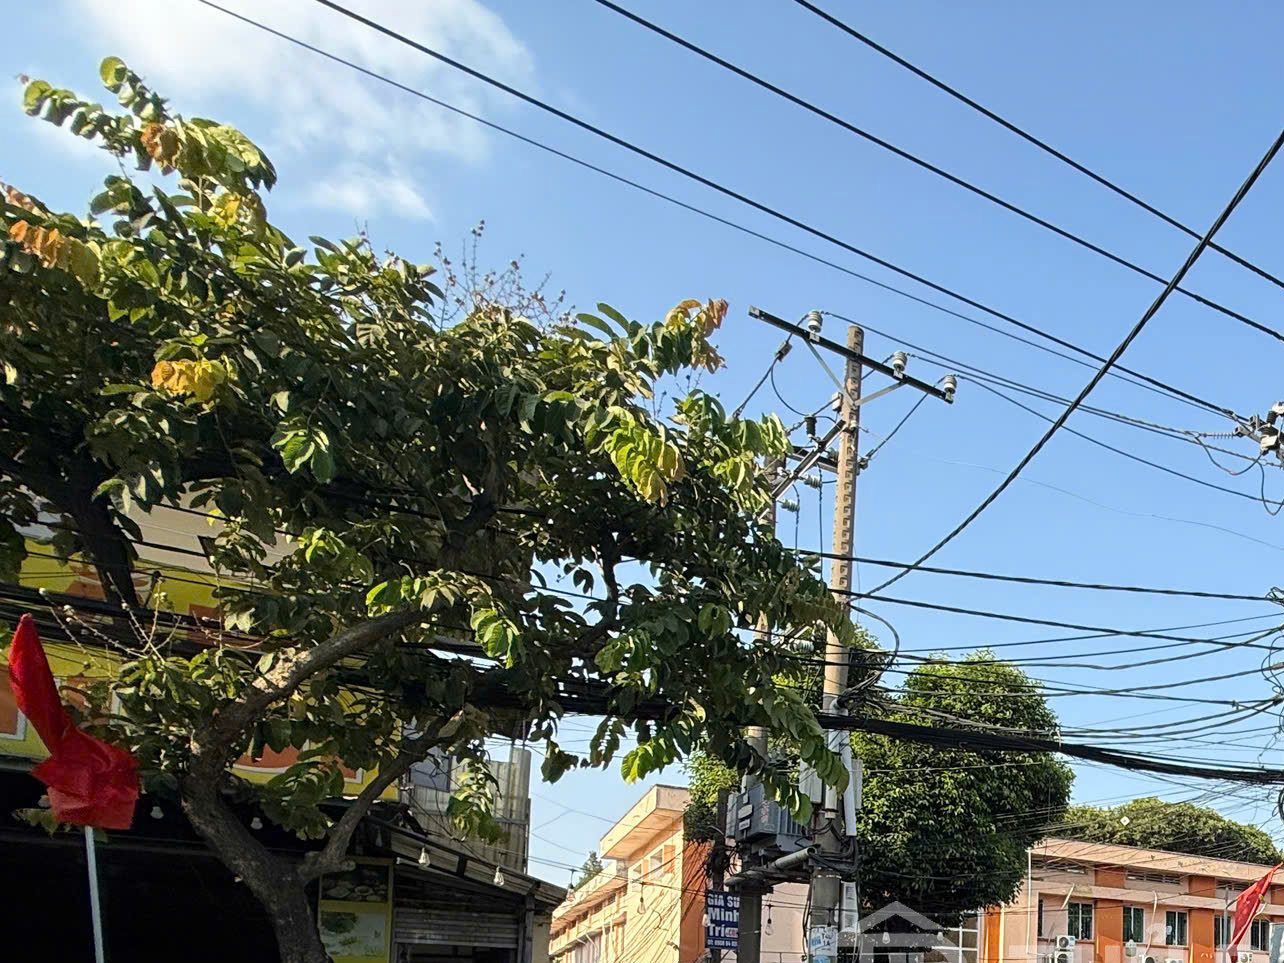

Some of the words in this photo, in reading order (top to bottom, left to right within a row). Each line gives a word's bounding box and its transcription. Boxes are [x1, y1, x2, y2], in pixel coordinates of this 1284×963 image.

[708, 894, 725, 906] GIA
[708, 907, 740, 922] Minh
[709, 924, 725, 937] Trí
